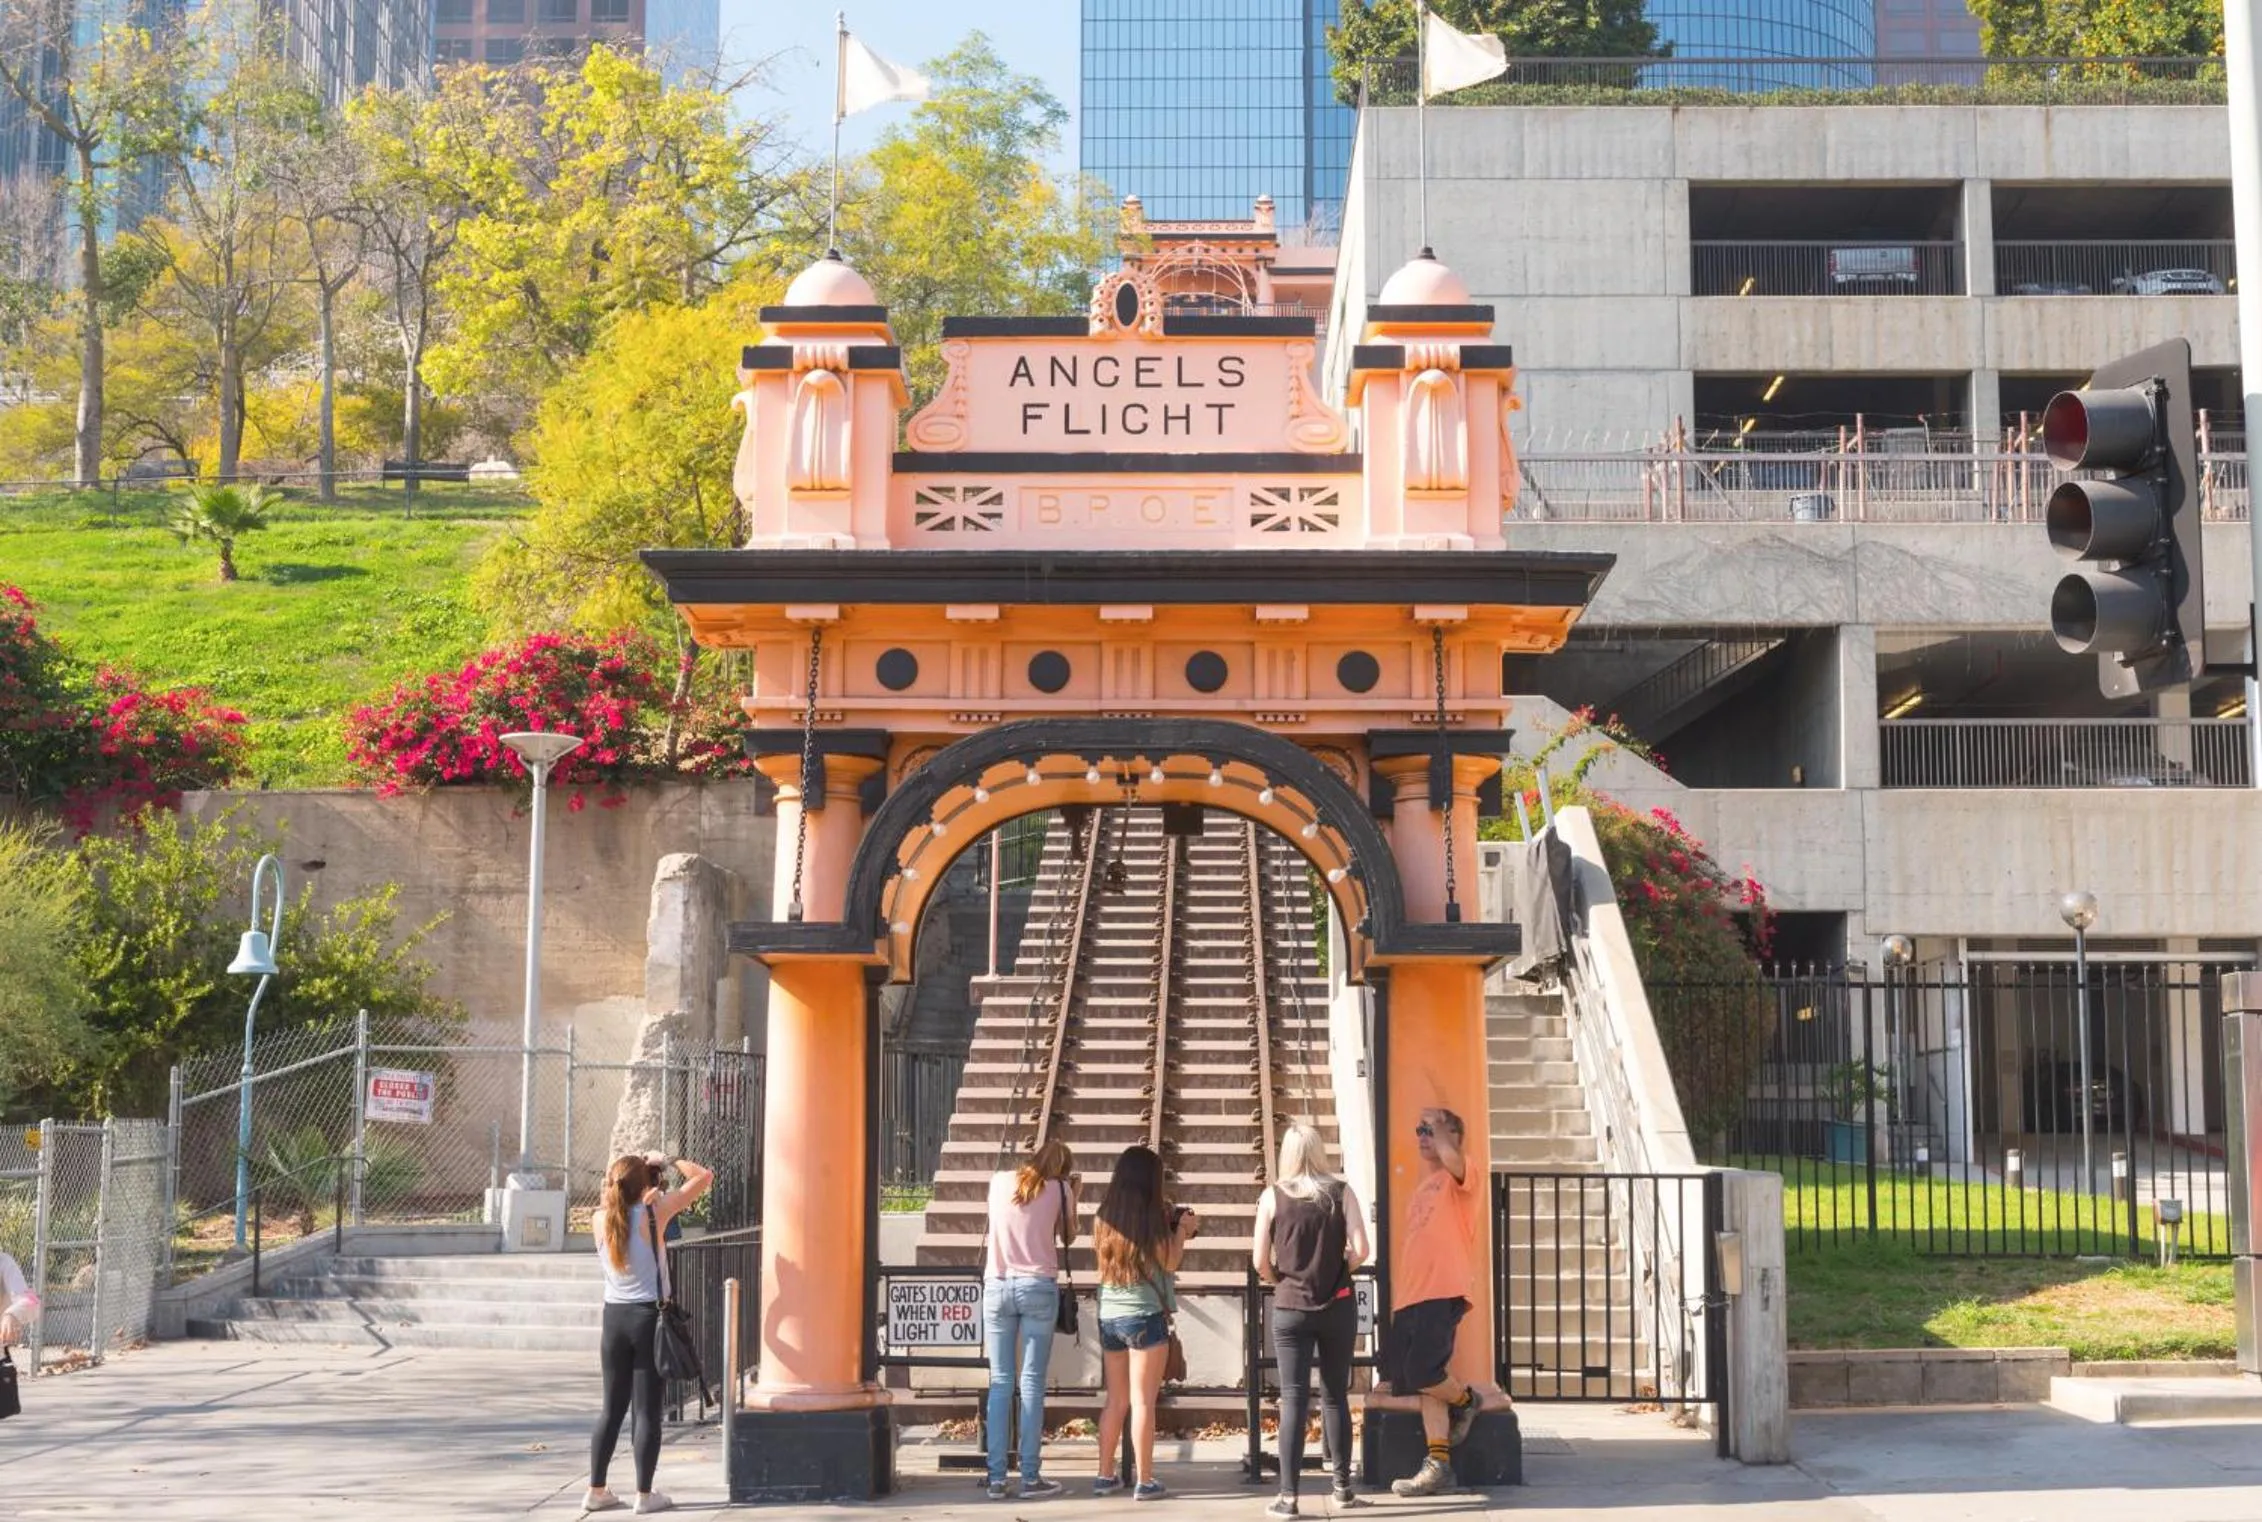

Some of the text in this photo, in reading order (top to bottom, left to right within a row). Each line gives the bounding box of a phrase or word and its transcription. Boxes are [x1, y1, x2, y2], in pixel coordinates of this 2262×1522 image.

[1009, 355, 1246, 388] ANGELS
[1022, 403, 1236, 435] FLIGHT
[890, 1285, 979, 1303] GATES LOCKED
[896, 1305, 973, 1321] WHEN RED
[894, 1323, 977, 1341] LIGHT ON
